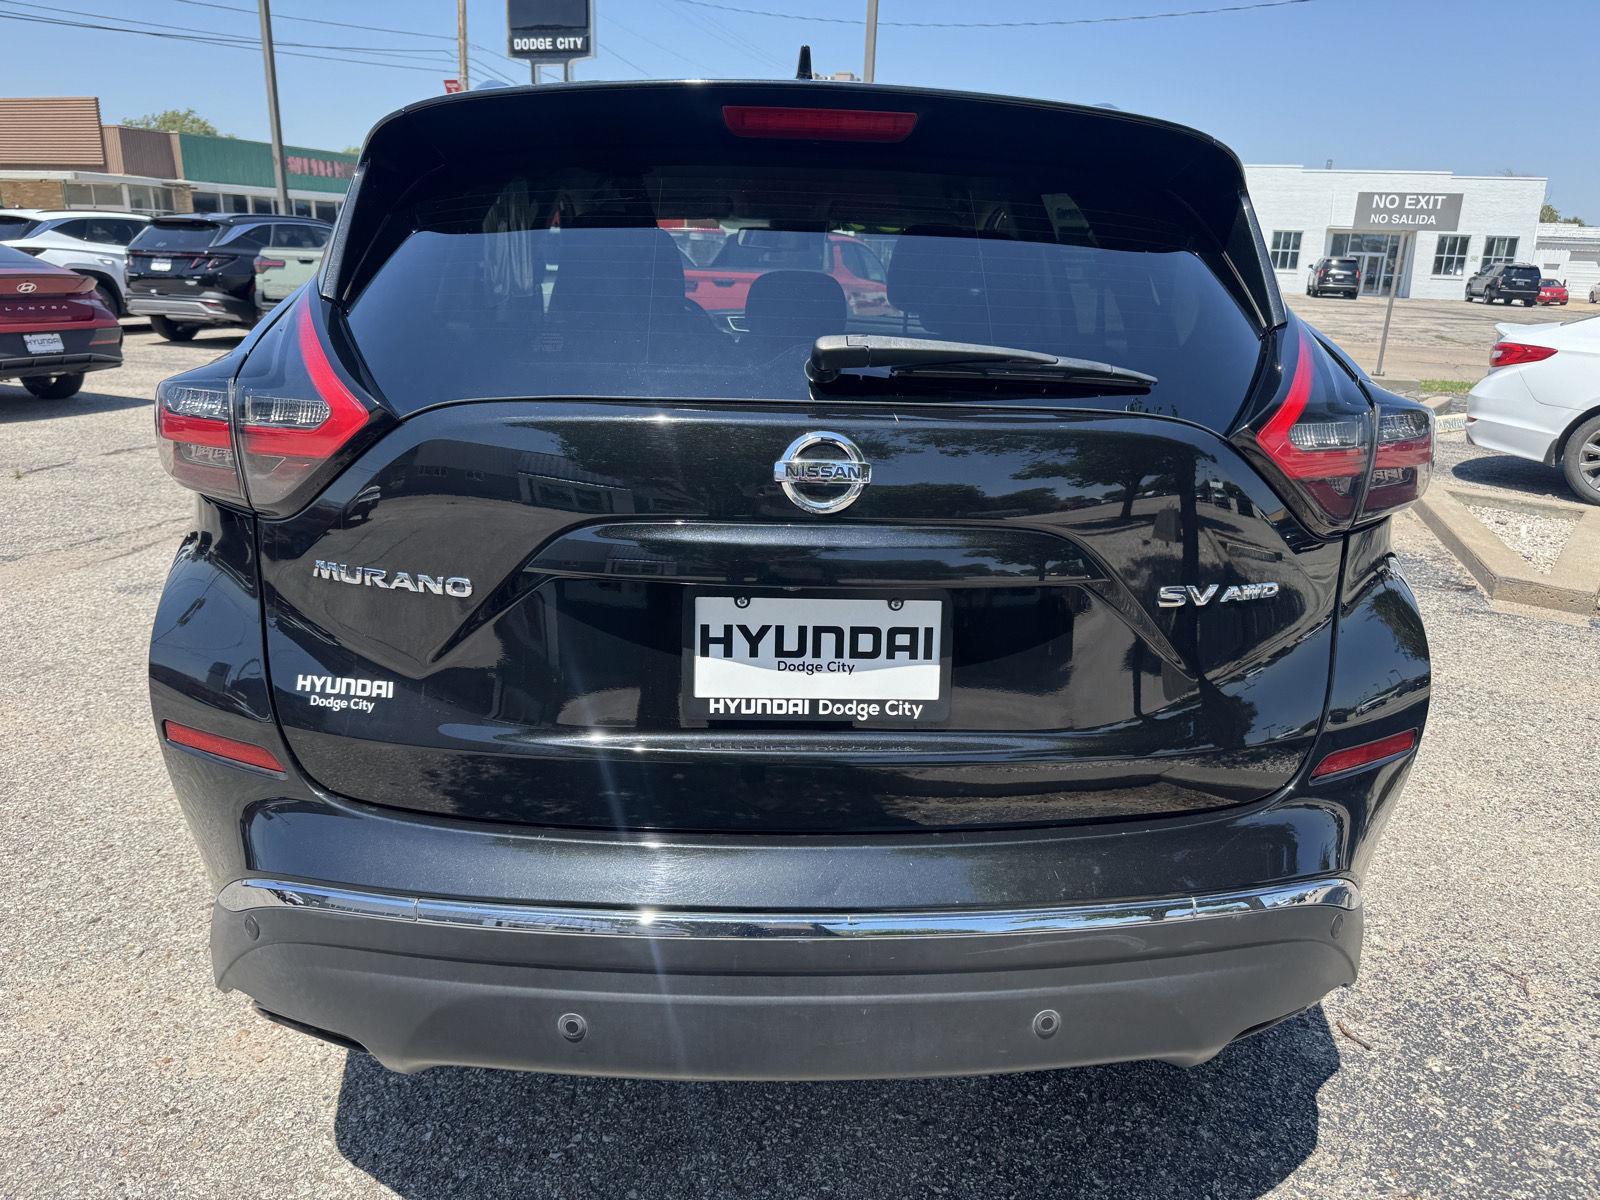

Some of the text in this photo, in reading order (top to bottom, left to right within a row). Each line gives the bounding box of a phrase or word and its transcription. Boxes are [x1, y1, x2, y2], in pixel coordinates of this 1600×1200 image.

[513, 37, 584, 50] DODGE CITY
[1372, 194, 1447, 210] NO EXIT
[1370, 213, 1437, 225] NO SALIDA
[785, 465, 861, 479] NISSAN
[313, 559, 473, 598] MURANO
[1158, 582, 1280, 607] SV AWD
[700, 624, 933, 660] HYUNDAI
[777, 661, 855, 675] Dodge City
[296, 674, 394, 698] HYUNDAI
[310, 695, 375, 713] Dodge City
[709, 699, 923, 721] HYUNDAI Dodge City
